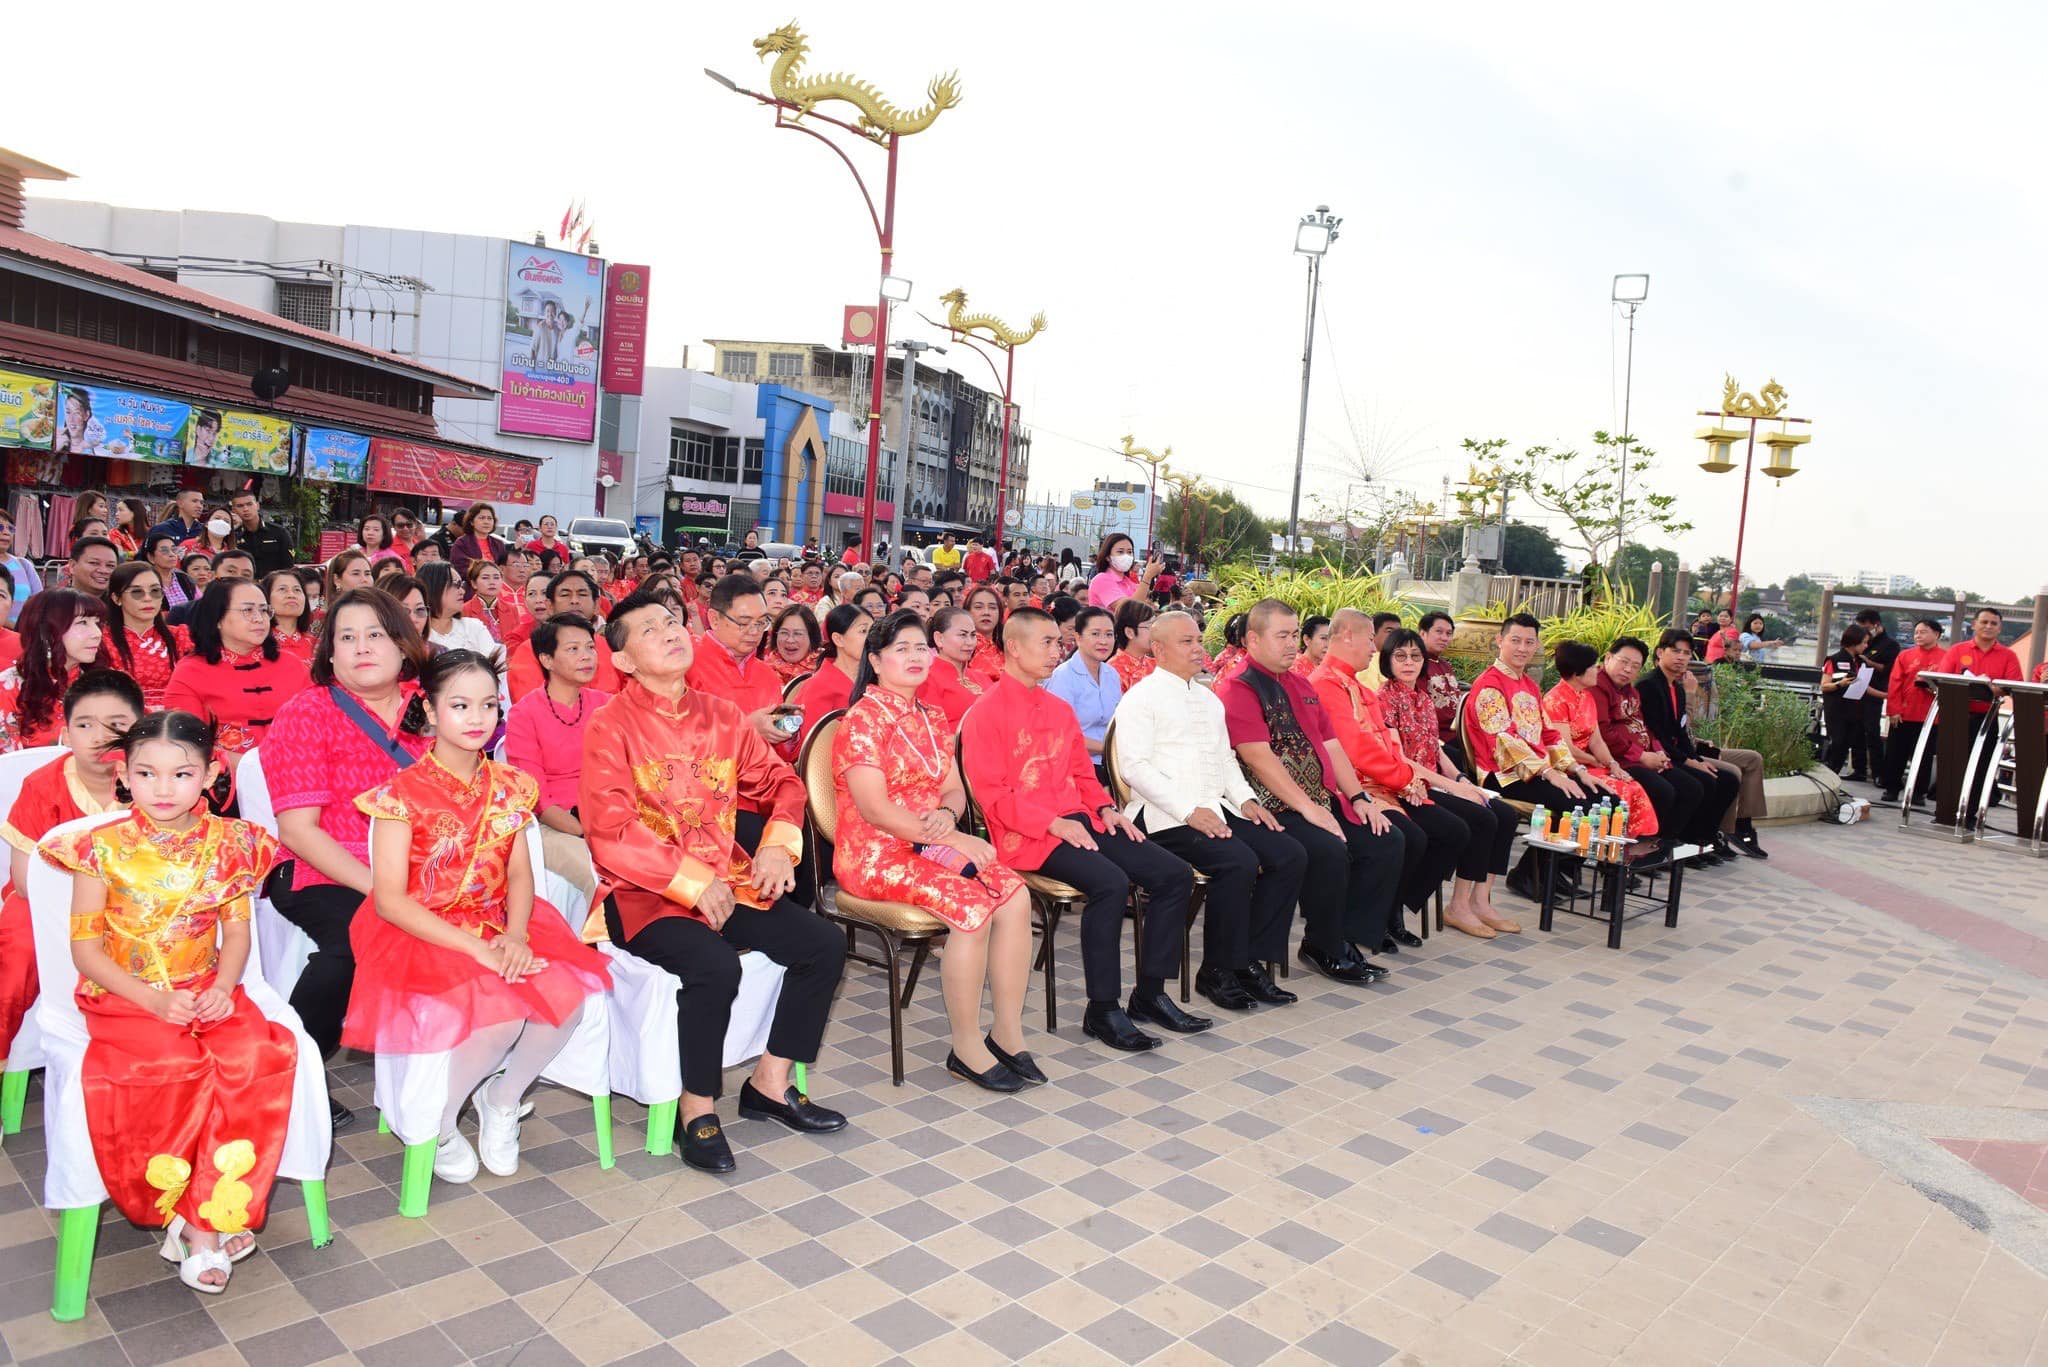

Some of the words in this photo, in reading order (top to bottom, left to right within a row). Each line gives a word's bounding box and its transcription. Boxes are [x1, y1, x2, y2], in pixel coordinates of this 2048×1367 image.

[546, 359, 590, 376] ฝันเป็นจริง
[509, 381, 587, 408] ไม่จำกัดวงเงินกู้
[682, 499, 727, 513] ออมสิน
